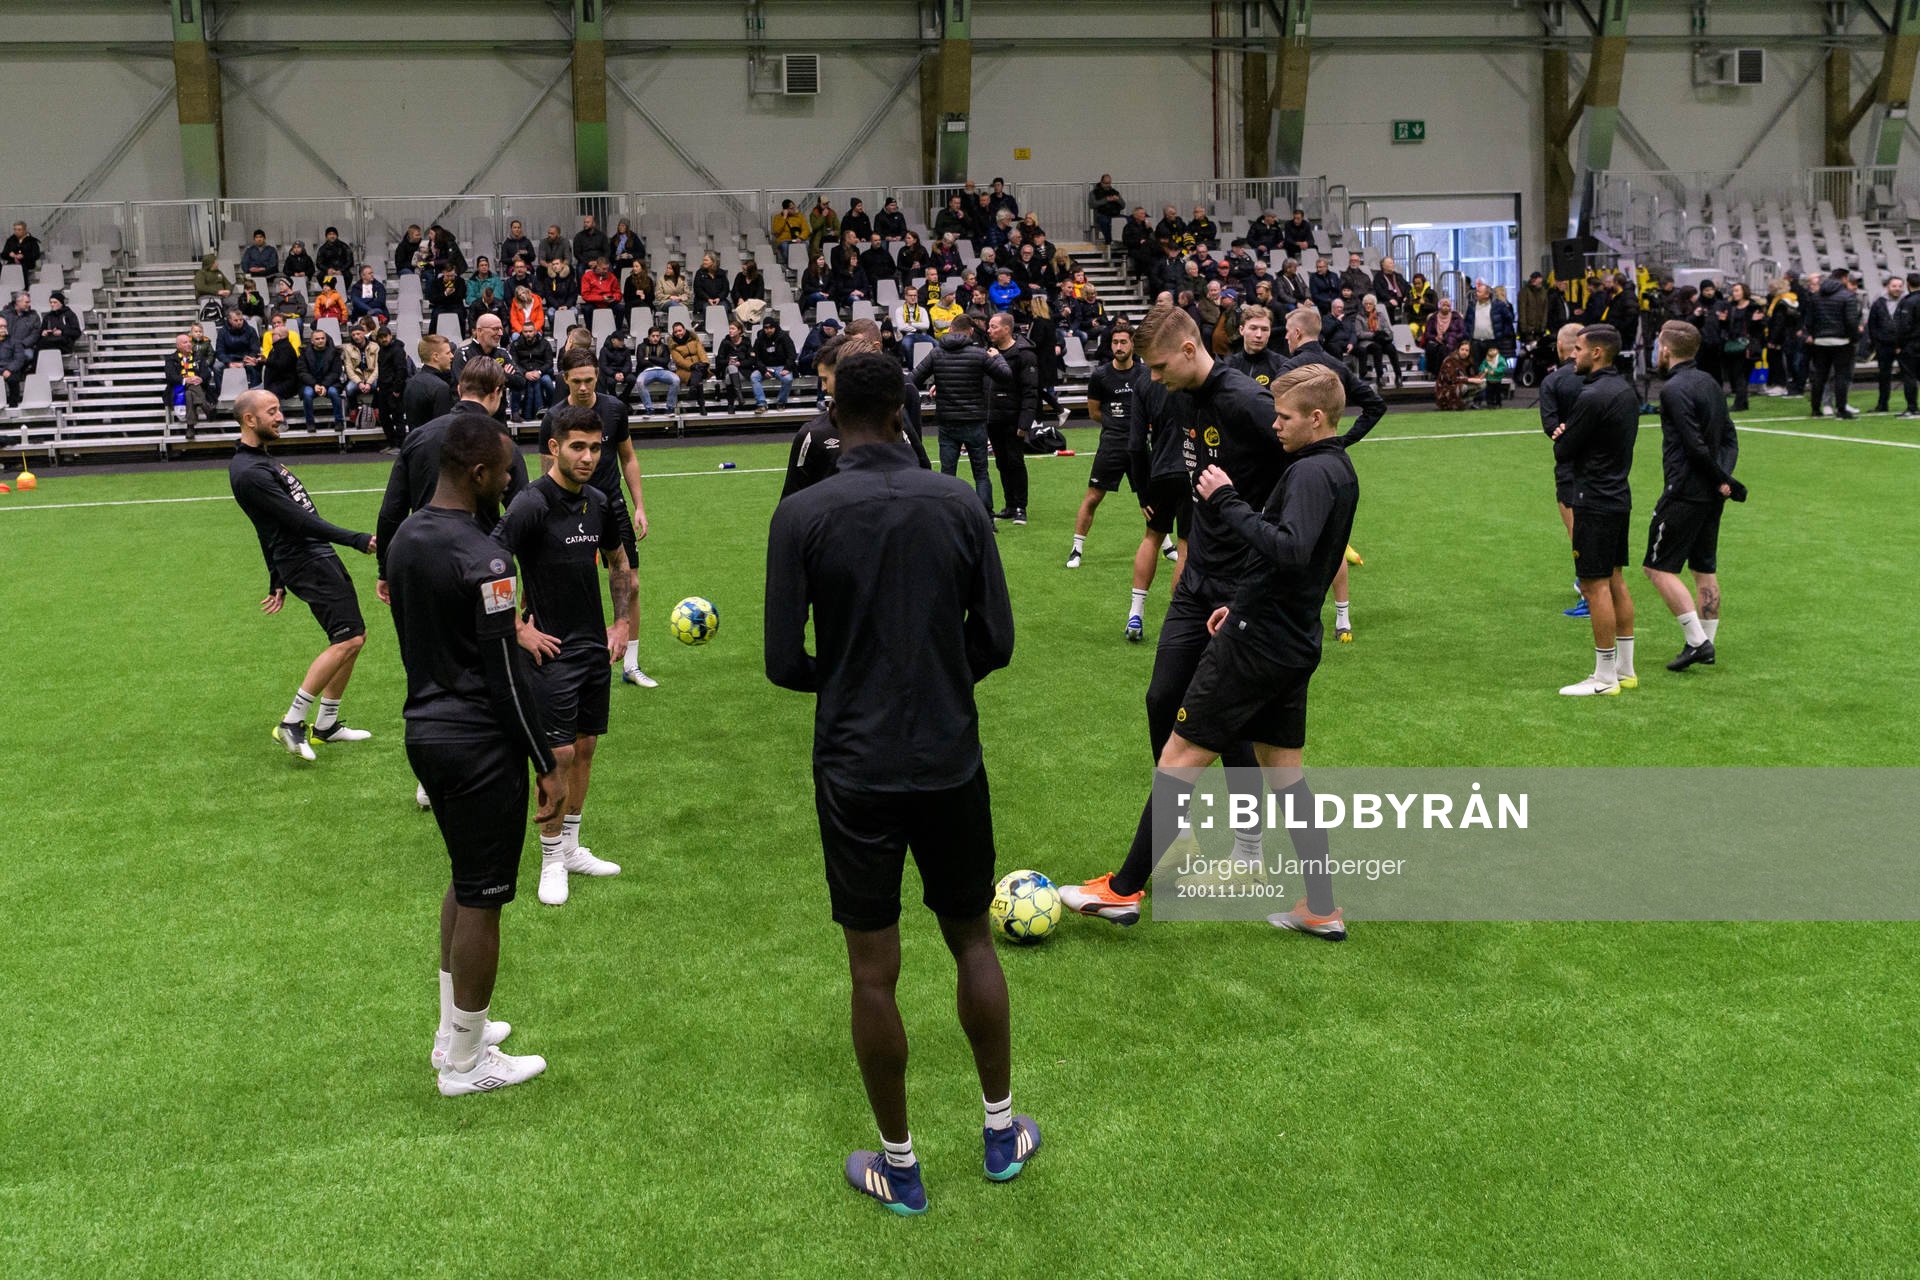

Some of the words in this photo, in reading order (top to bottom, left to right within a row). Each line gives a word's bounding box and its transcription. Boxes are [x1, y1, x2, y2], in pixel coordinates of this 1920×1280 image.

[1208, 448, 1218, 458] 31
[565, 535, 599, 544] CATAPULT
[482, 884, 509, 895] umbro
